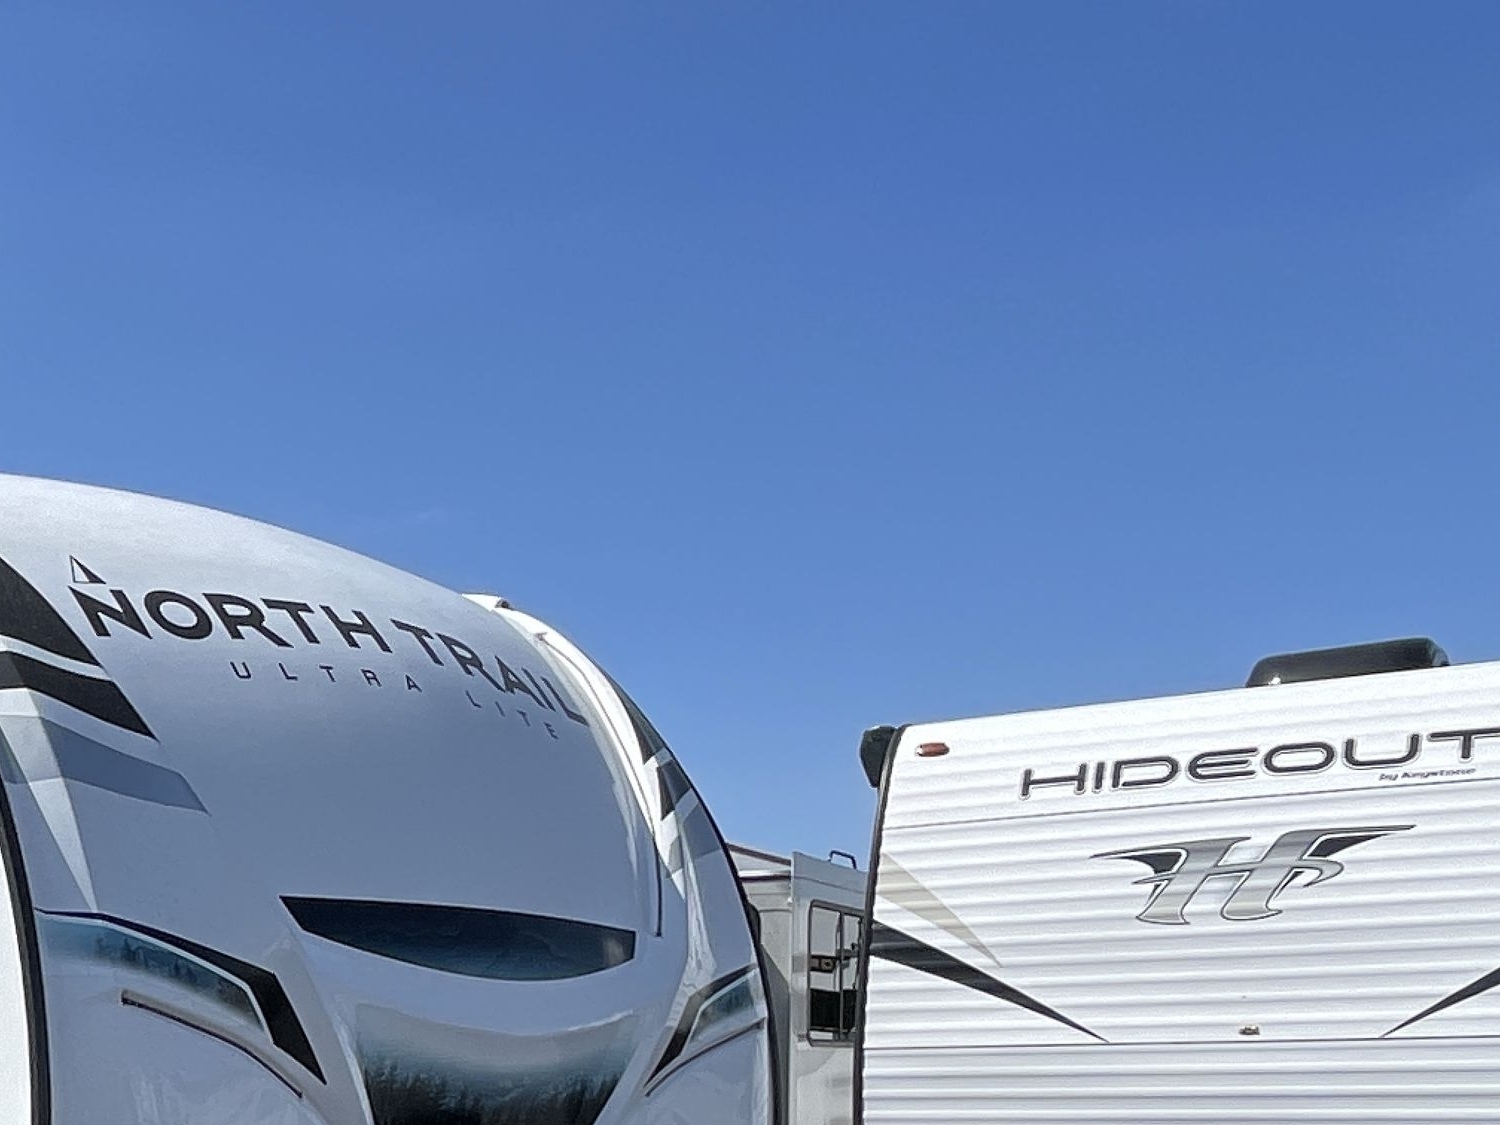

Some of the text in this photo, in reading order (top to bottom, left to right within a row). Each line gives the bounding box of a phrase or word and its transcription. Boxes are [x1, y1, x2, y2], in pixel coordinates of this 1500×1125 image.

[67, 585, 590, 726] NORTH TRAIL
[231, 661, 559, 740] ULTRA LITE
[1019, 727, 1500, 798] HIDEOUT
